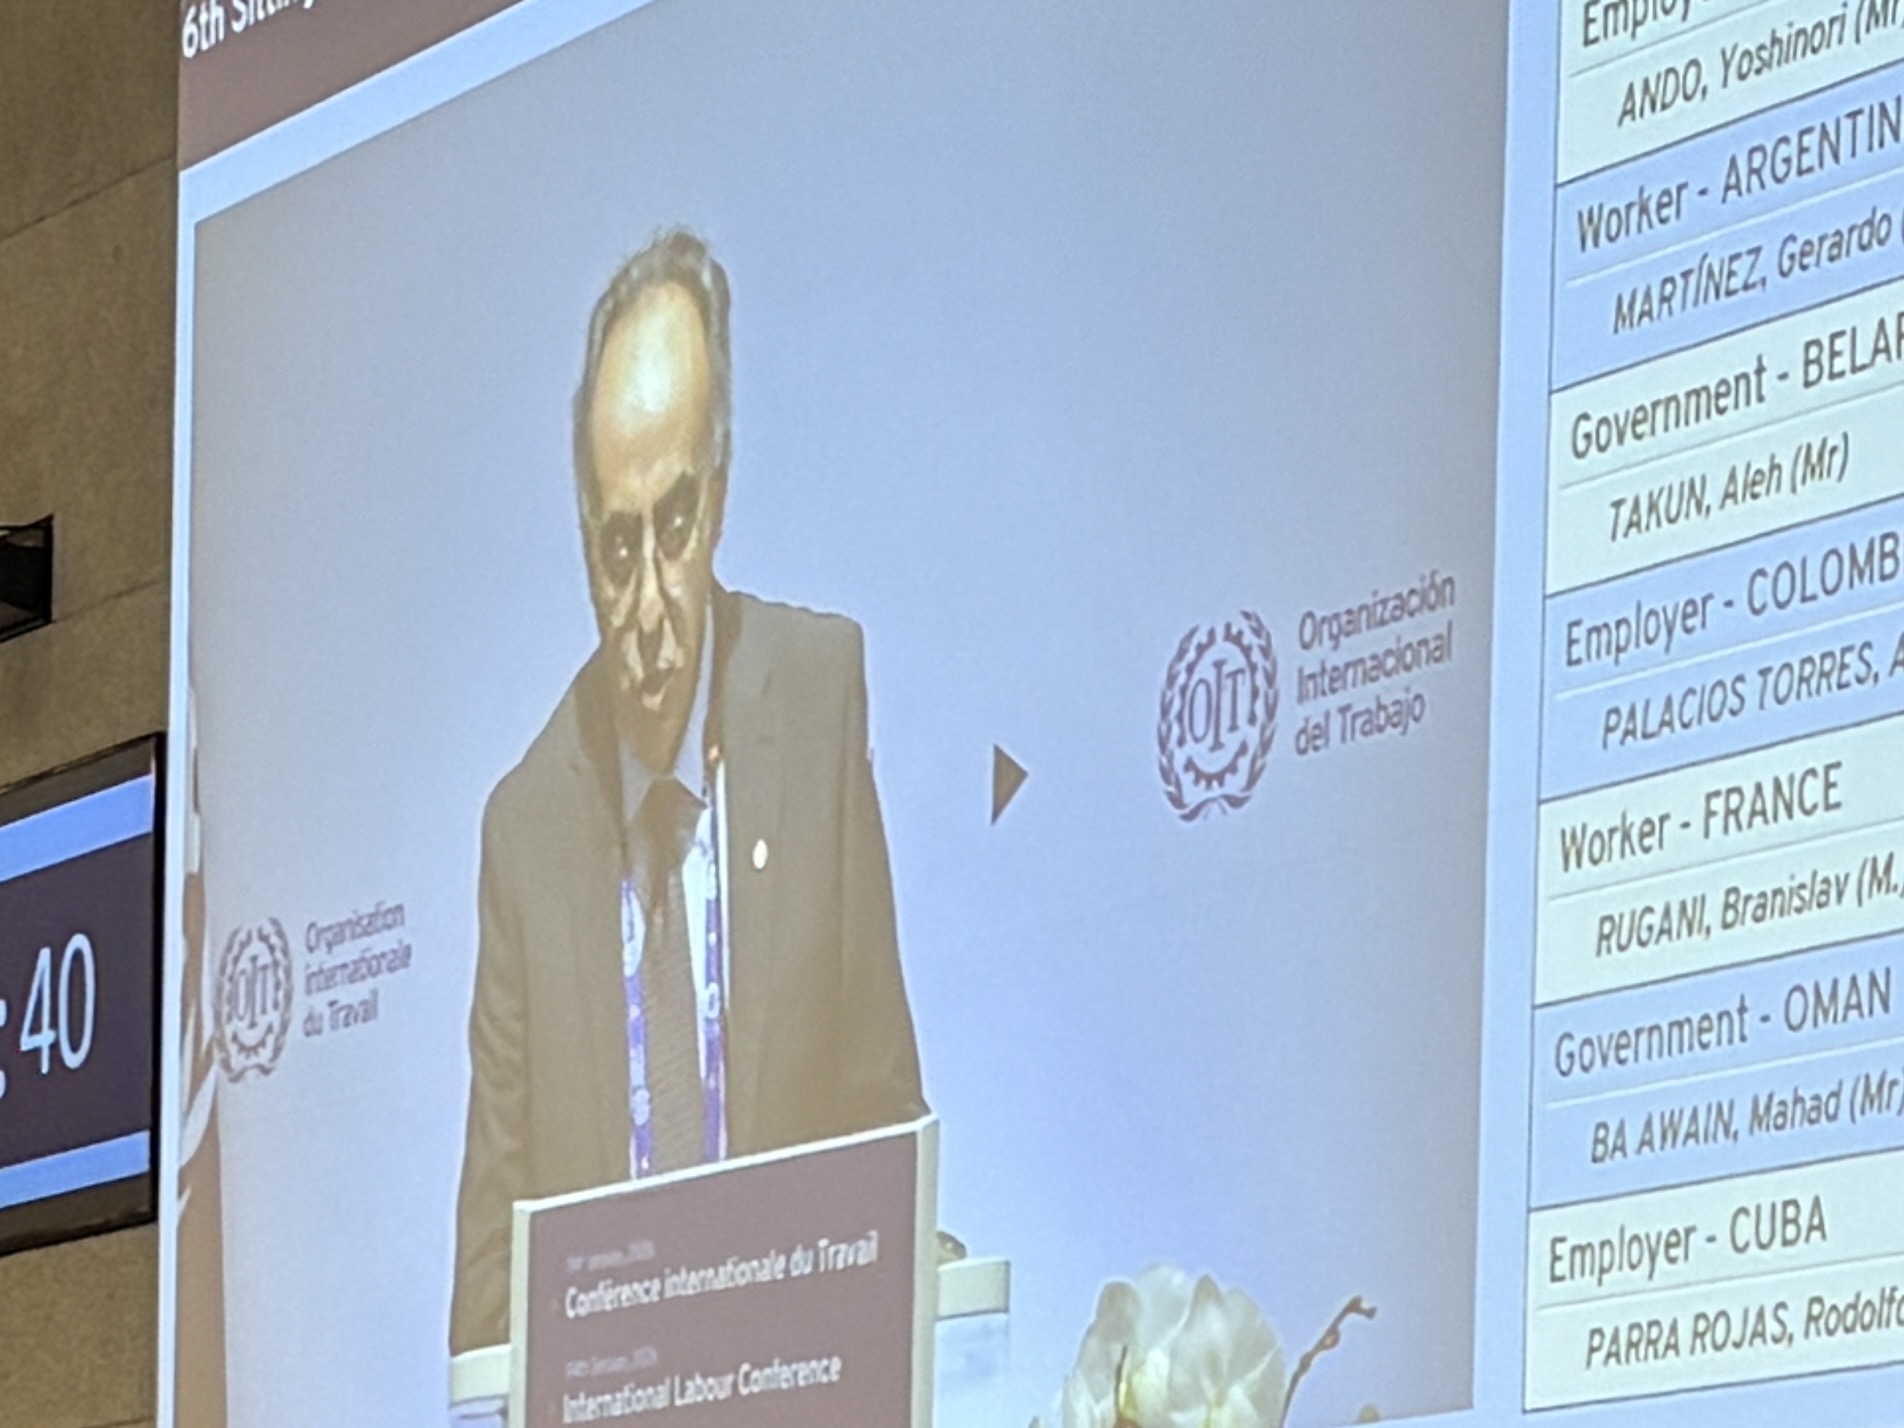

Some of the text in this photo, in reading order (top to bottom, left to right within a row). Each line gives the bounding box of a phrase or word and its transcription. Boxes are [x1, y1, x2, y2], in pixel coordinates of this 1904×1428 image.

[1617, 58, 1708, 128] ANDO,
[1721, 4, 1846, 89] Yoshinori
[1577, 180, 1688, 253] Worker
[1697, 187, 1709, 197] -
[1613, 245, 1767, 334] MARTÍNEZ,
[1777, 207, 1892, 278] Gerardo
[1571, 353, 1767, 460] Government
[1776, 371, 1789, 382] -
[1609, 431, 1849, 542] TAKUN, Aleh (Mr)
[1299, 569, 1456, 651] Organización
[1565, 593, 1714, 668] Employer
[1722, 598, 1735, 608] -
[1296, 619, 1453, 705] Internacional
[1602, 674, 1746, 750] PALACIOS
[1756, 640, 1879, 711] TORRES,
[1295, 690, 1426, 757] del Trabajo
[1560, 761, 1843, 872] Worker - FRANCE
[1595, 895, 1711, 958] RUGANI,
[1721, 868, 1850, 931] Branislav
[1554, 967, 1892, 1077] Government - OMAN
[1591, 1120, 1627, 1163] BA
[1637, 1100, 1739, 1156] AWAIN,
[1748, 1072, 1840, 1136] Mahad
[790, 1246, 812, 1276] du
[1549, 1195, 1827, 1284] Employer - CUBA
[1585, 1315, 1680, 1370] PARRA
[1689, 1301, 1793, 1356] ROJAS,
